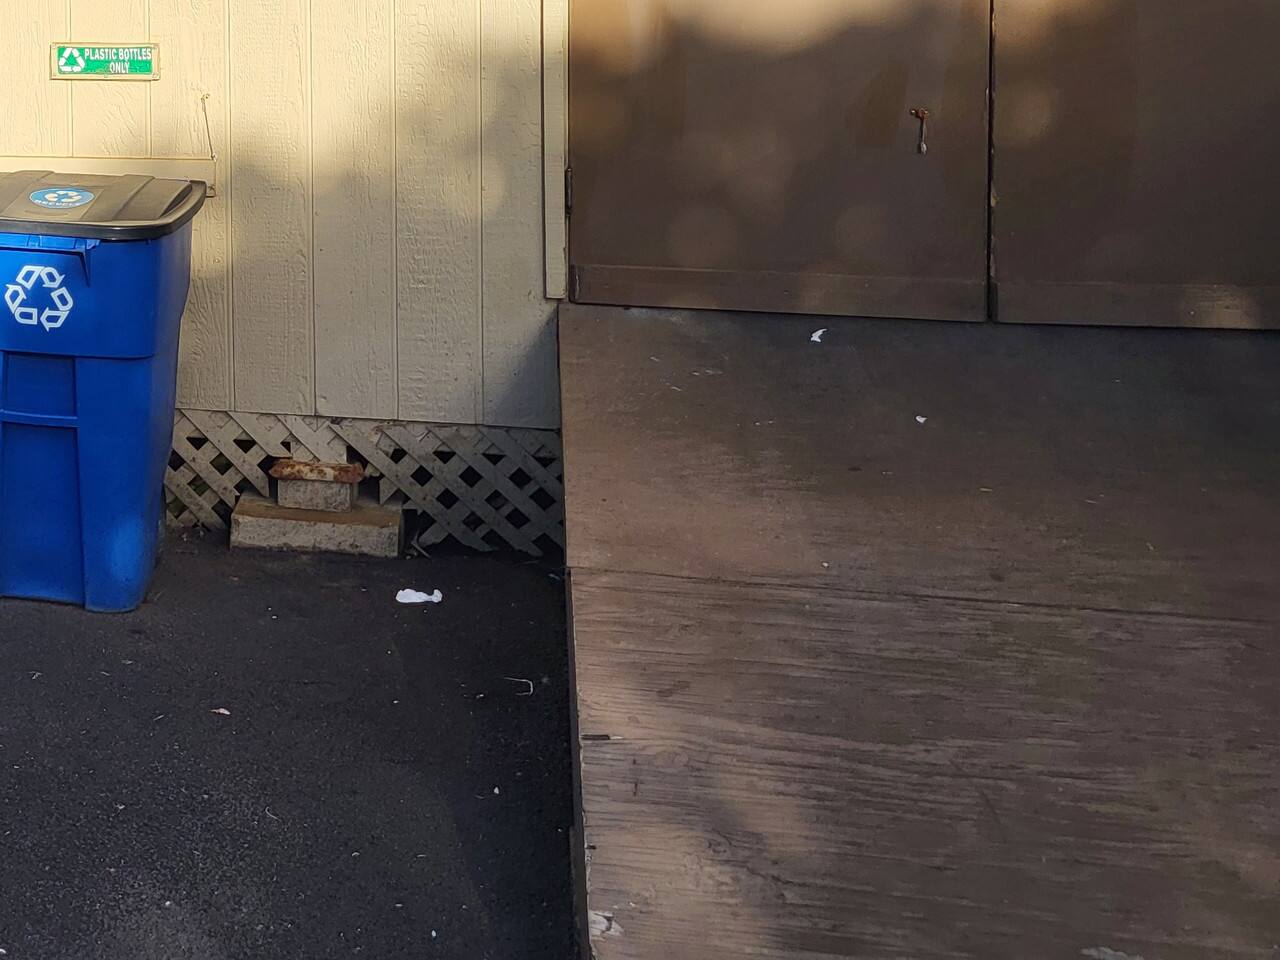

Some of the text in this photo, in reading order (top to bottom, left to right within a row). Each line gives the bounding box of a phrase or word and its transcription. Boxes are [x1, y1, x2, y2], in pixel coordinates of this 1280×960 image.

[84, 47, 152, 60] PLASTIC BOTTLES
[109, 61, 130, 74] ONLY
